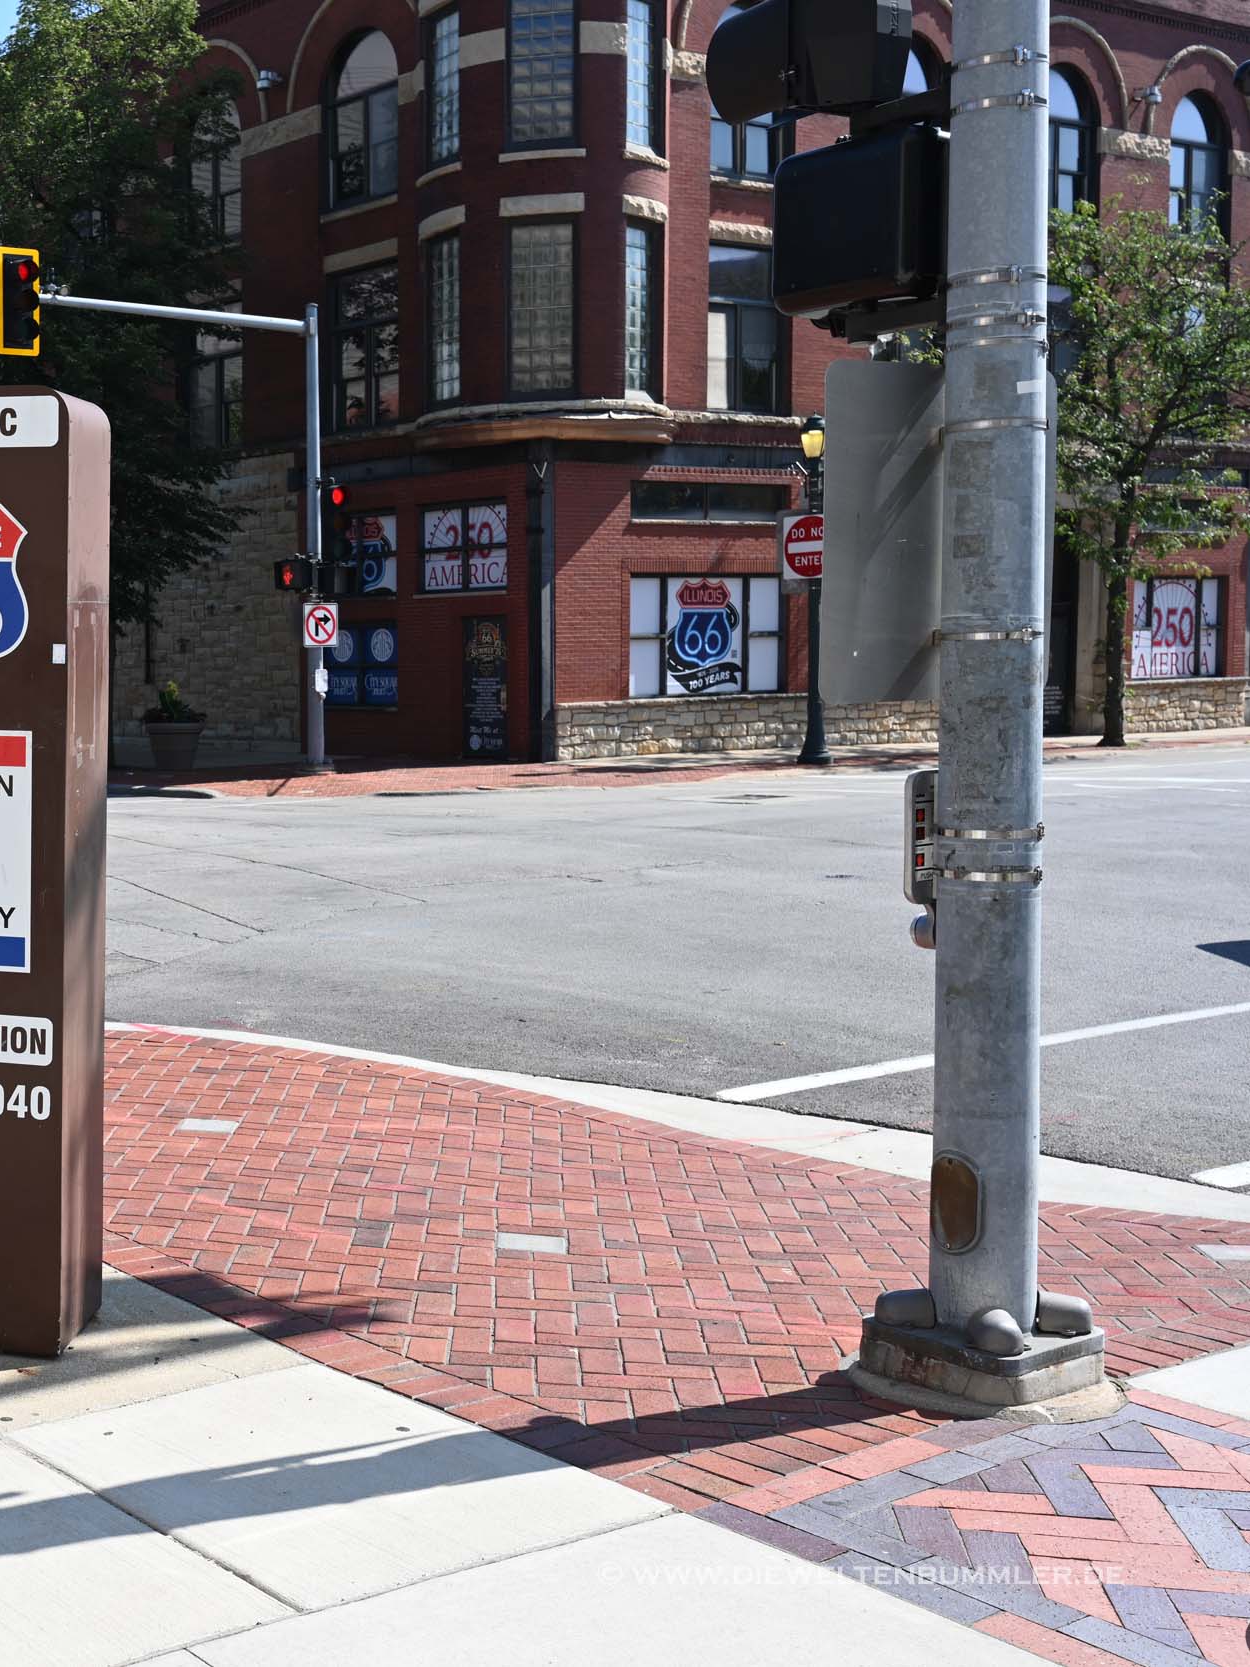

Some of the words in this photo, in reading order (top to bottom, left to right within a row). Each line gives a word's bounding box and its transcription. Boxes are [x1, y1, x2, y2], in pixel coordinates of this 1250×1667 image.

[446, 522, 493, 560] 250
[792, 528, 805, 538] DO
[811, 526, 824, 537] NO
[795, 554, 823, 567] ENTE
[684, 589, 723, 603] ILLINOIS
[685, 615, 721, 655] 66
[1152, 607, 1194, 648] 250
[689, 679, 703, 690] 100
[704, 671, 730, 686] YEARS
